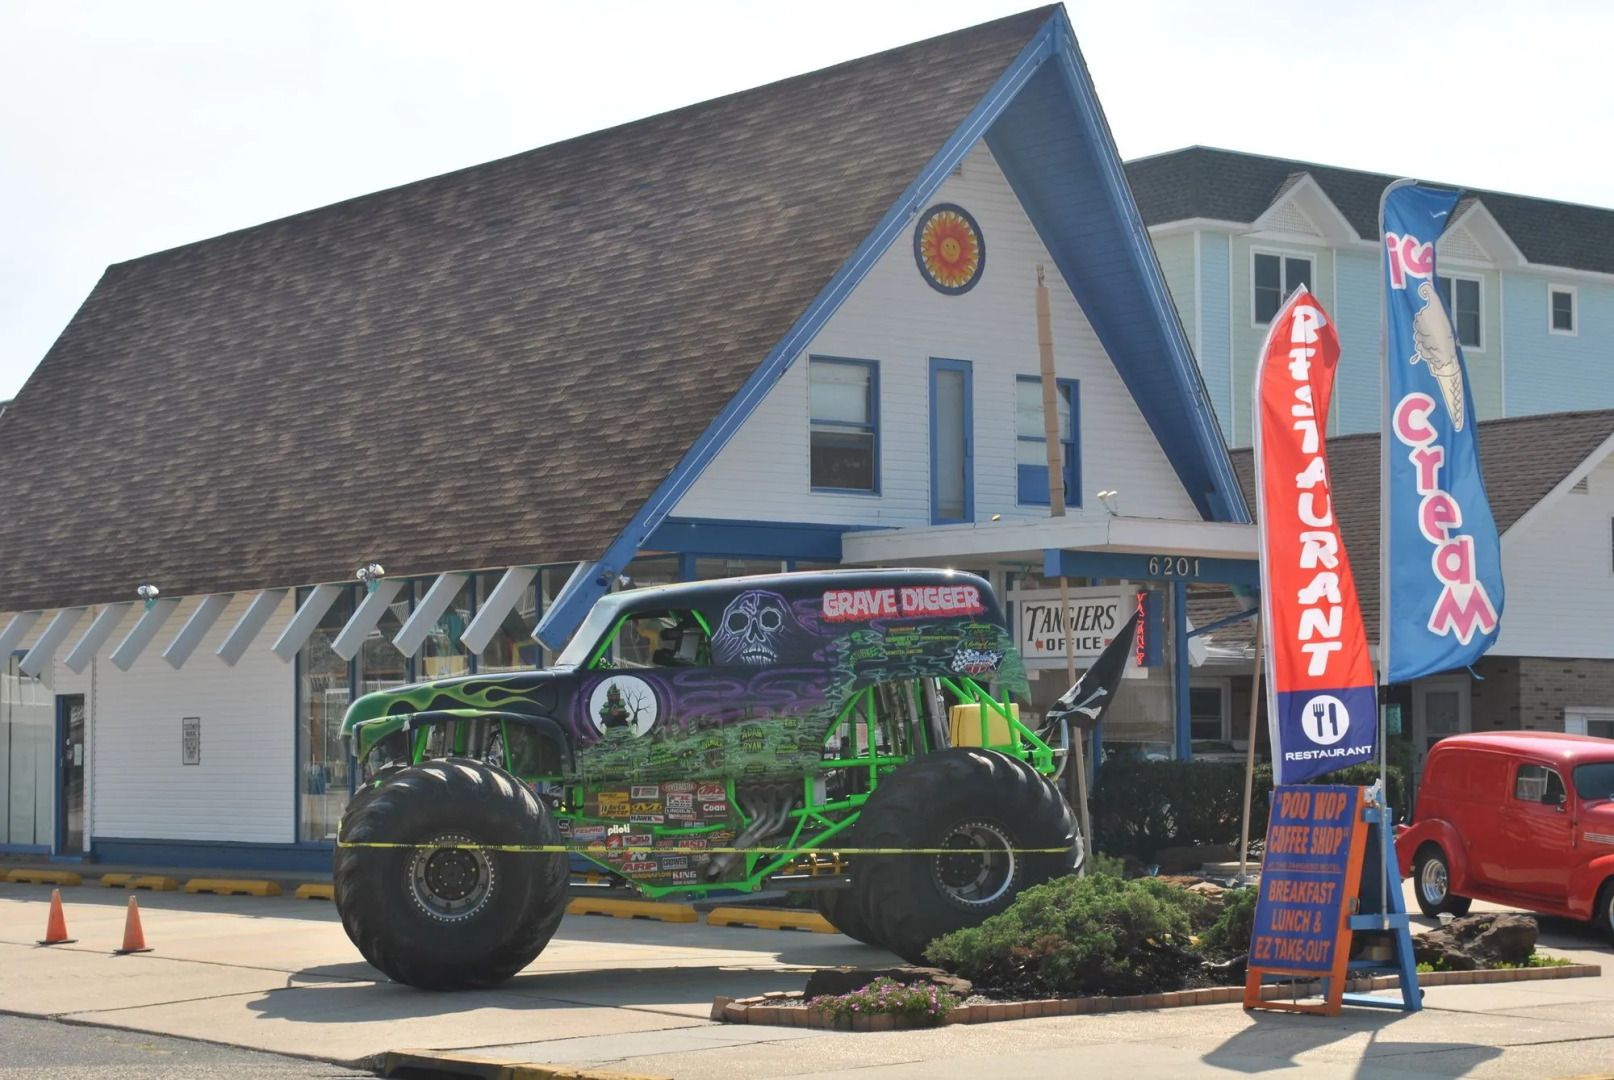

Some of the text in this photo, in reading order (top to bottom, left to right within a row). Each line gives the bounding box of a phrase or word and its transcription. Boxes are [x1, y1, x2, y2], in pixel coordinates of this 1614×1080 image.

[1288, 305, 1343, 676] RESTAURANT
[1149, 556, 1200, 577] 6201
[823, 586, 980, 617] GRAVE DIGGER
[1285, 745, 1372, 761] RESTAURANT
[1313, 792, 1347, 820] WOP
[607, 824, 631, 836] piloti
[1269, 826, 1310, 854] COFFEE
[680, 839, 707, 849] MSD
[622, 862, 656, 871] ARP
[672, 870, 697, 879] KING
[1268, 880, 1336, 905] BREAKFAST
[1271, 908, 1322, 933] LUNCH &
[1254, 936, 1331, 963] EZ TAKE-OUT
